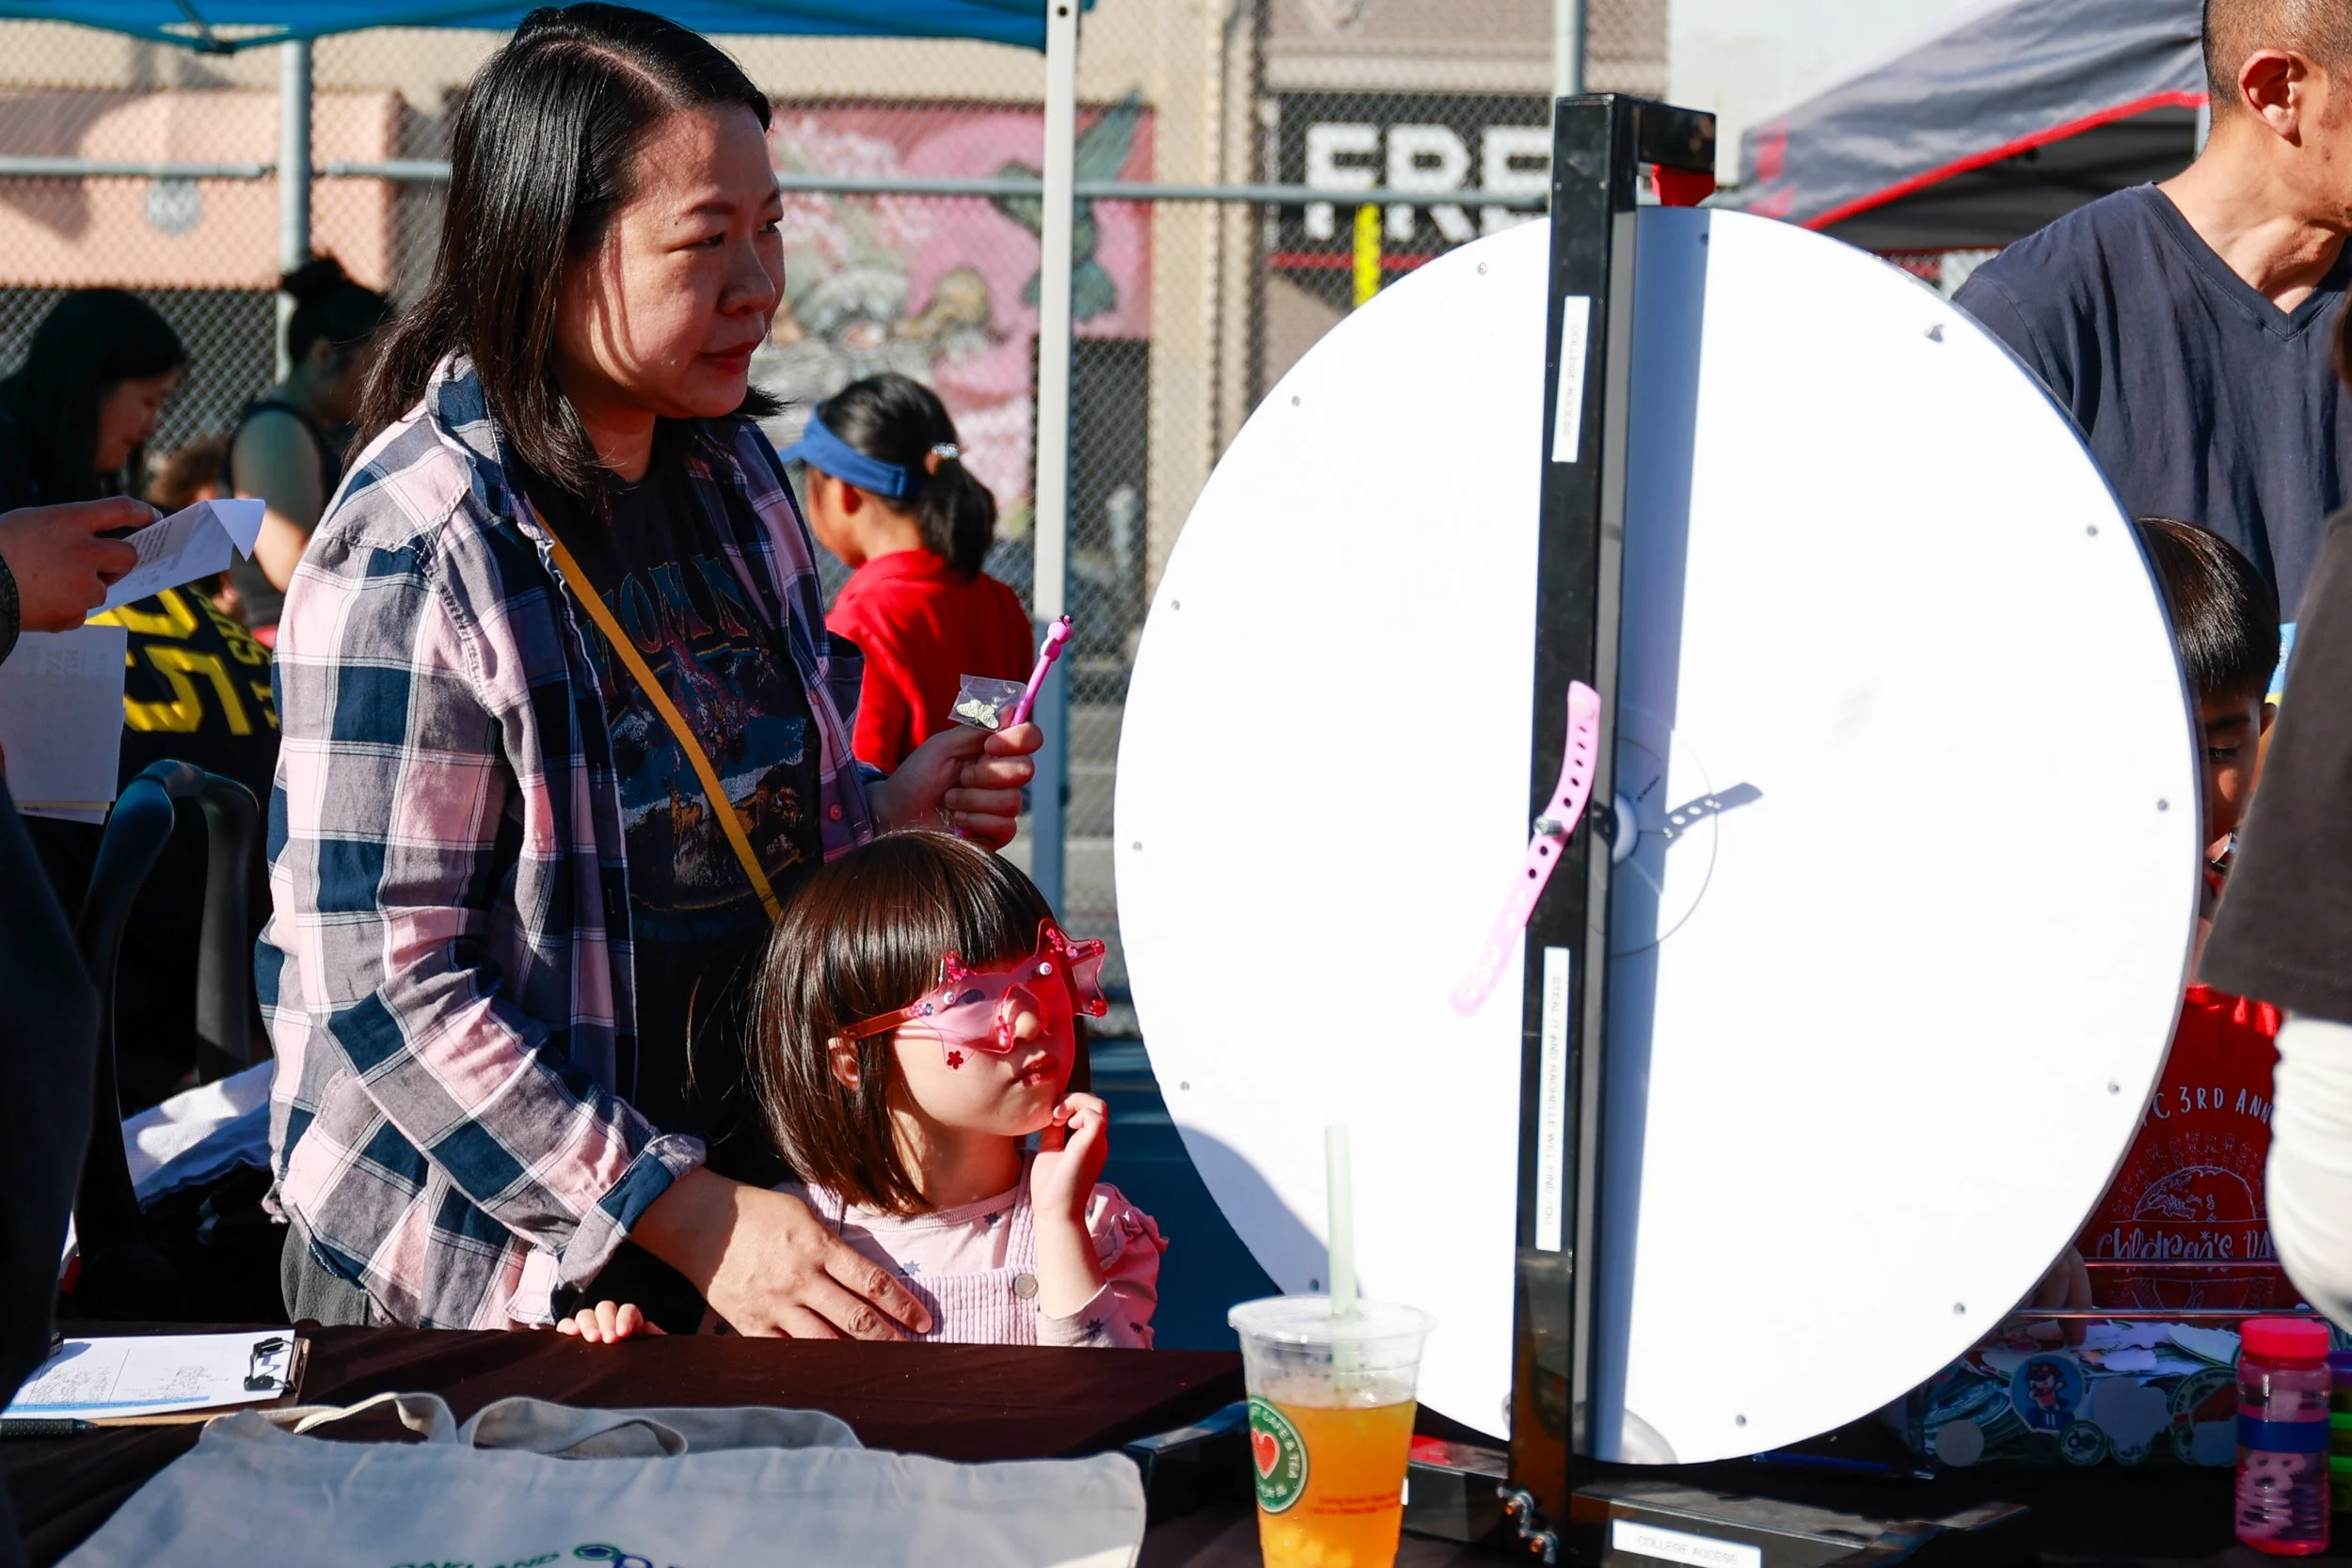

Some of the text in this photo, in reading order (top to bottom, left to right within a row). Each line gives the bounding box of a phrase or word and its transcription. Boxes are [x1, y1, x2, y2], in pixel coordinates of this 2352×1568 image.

[1549, 1034, 1560, 1060] AND
[2149, 1092, 2170, 1121] C
[2178, 1086, 2224, 1114] 3RD
[1545, 1164, 1556, 1195] FIND
[2243, 1229, 2274, 1269] DA
[1288, 1451, 1300, 1479] TEA
[1636, 1535, 1739, 1565] COLLEGE ACCESS
